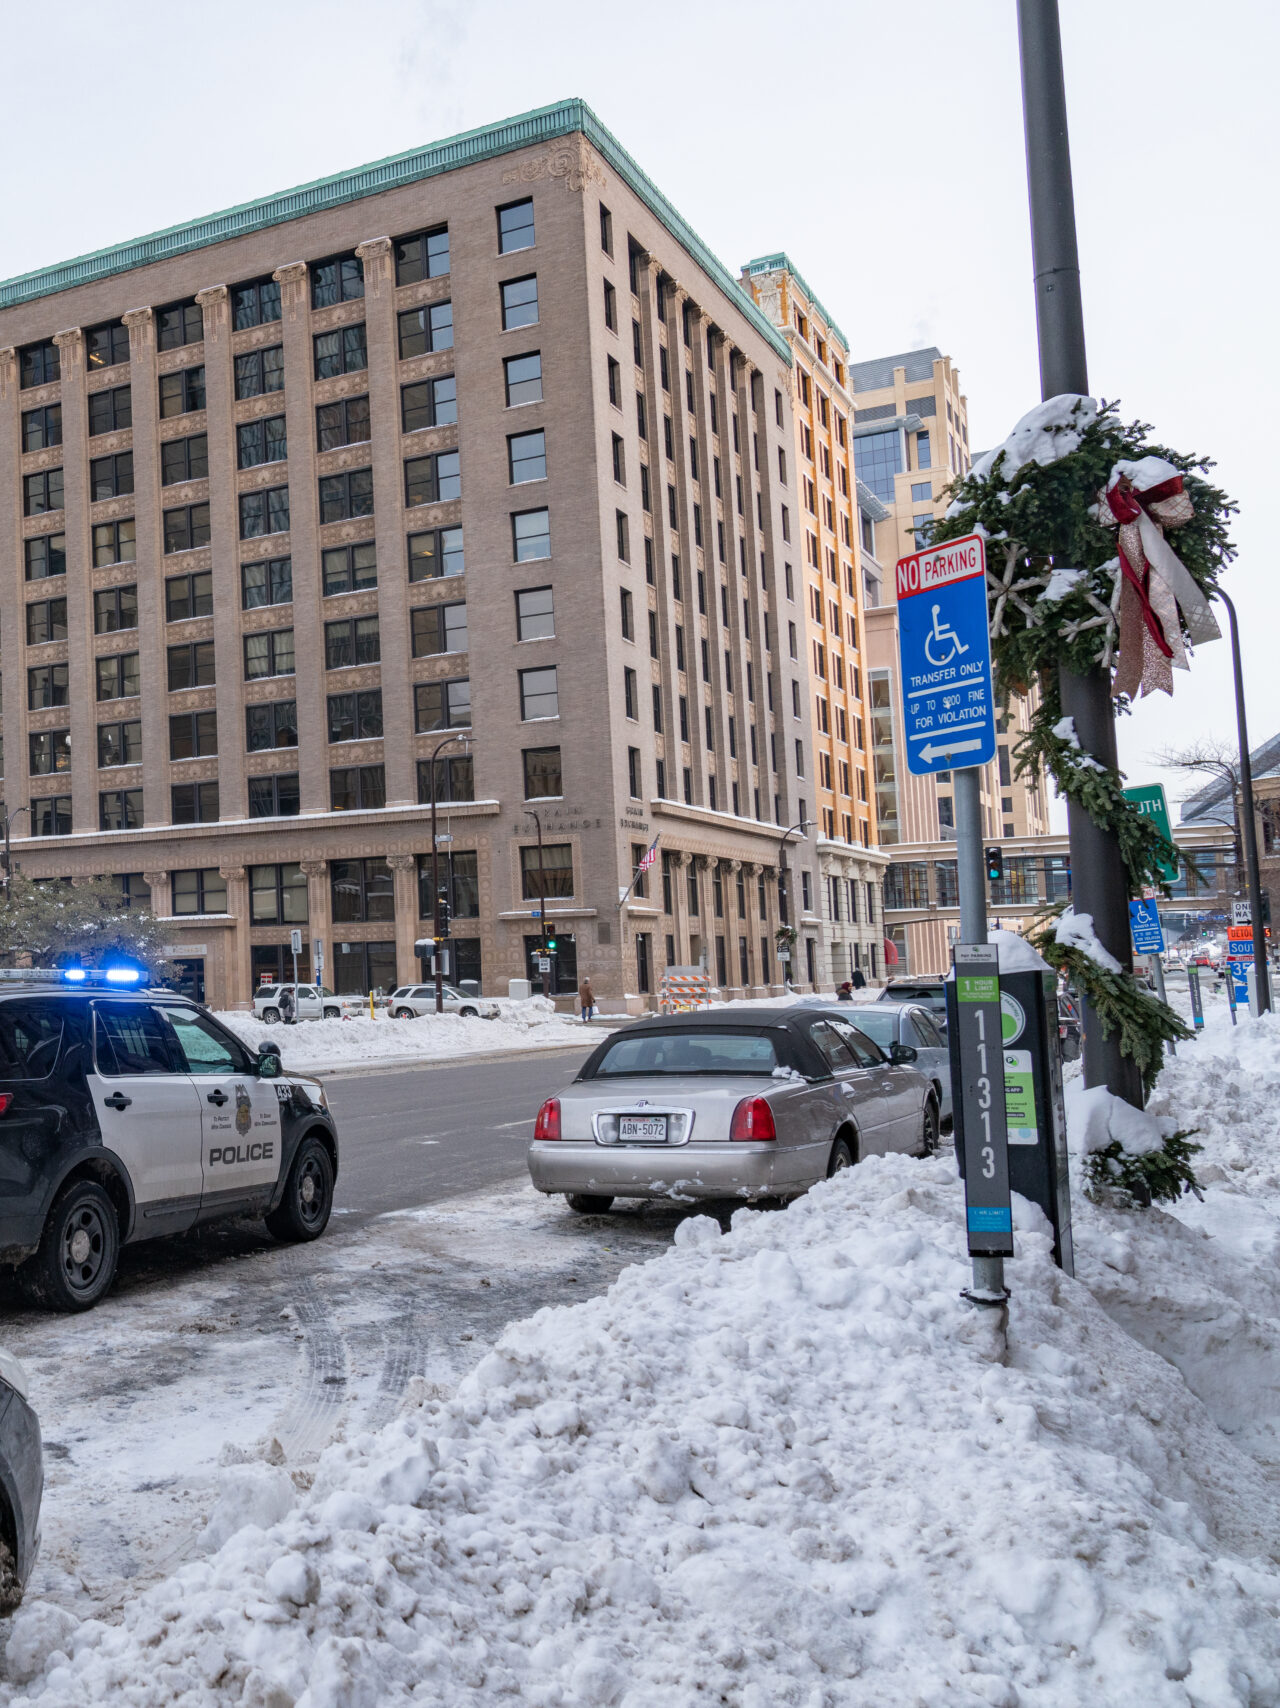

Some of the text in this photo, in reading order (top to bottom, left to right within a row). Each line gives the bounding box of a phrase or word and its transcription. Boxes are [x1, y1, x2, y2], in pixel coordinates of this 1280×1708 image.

[897, 546, 976, 594] NO PARKING
[910, 660, 984, 687] TRANSFER ONLY
[910, 703, 920, 715] UP
[926, 700, 936, 711] TO
[968, 689, 985, 702] FINE
[915, 705, 986, 729] FOR VIOLATION
[1235, 903, 1252, 911] ON
[1231, 929, 1253, 938] DETO
[1231, 943, 1254, 953] SOUT
[278, 1085, 292, 1098] 433
[974, 1009, 995, 1178] 11313
[622, 1123, 664, 1136] ABN-5072
[209, 1142, 274, 1167] POLICE
